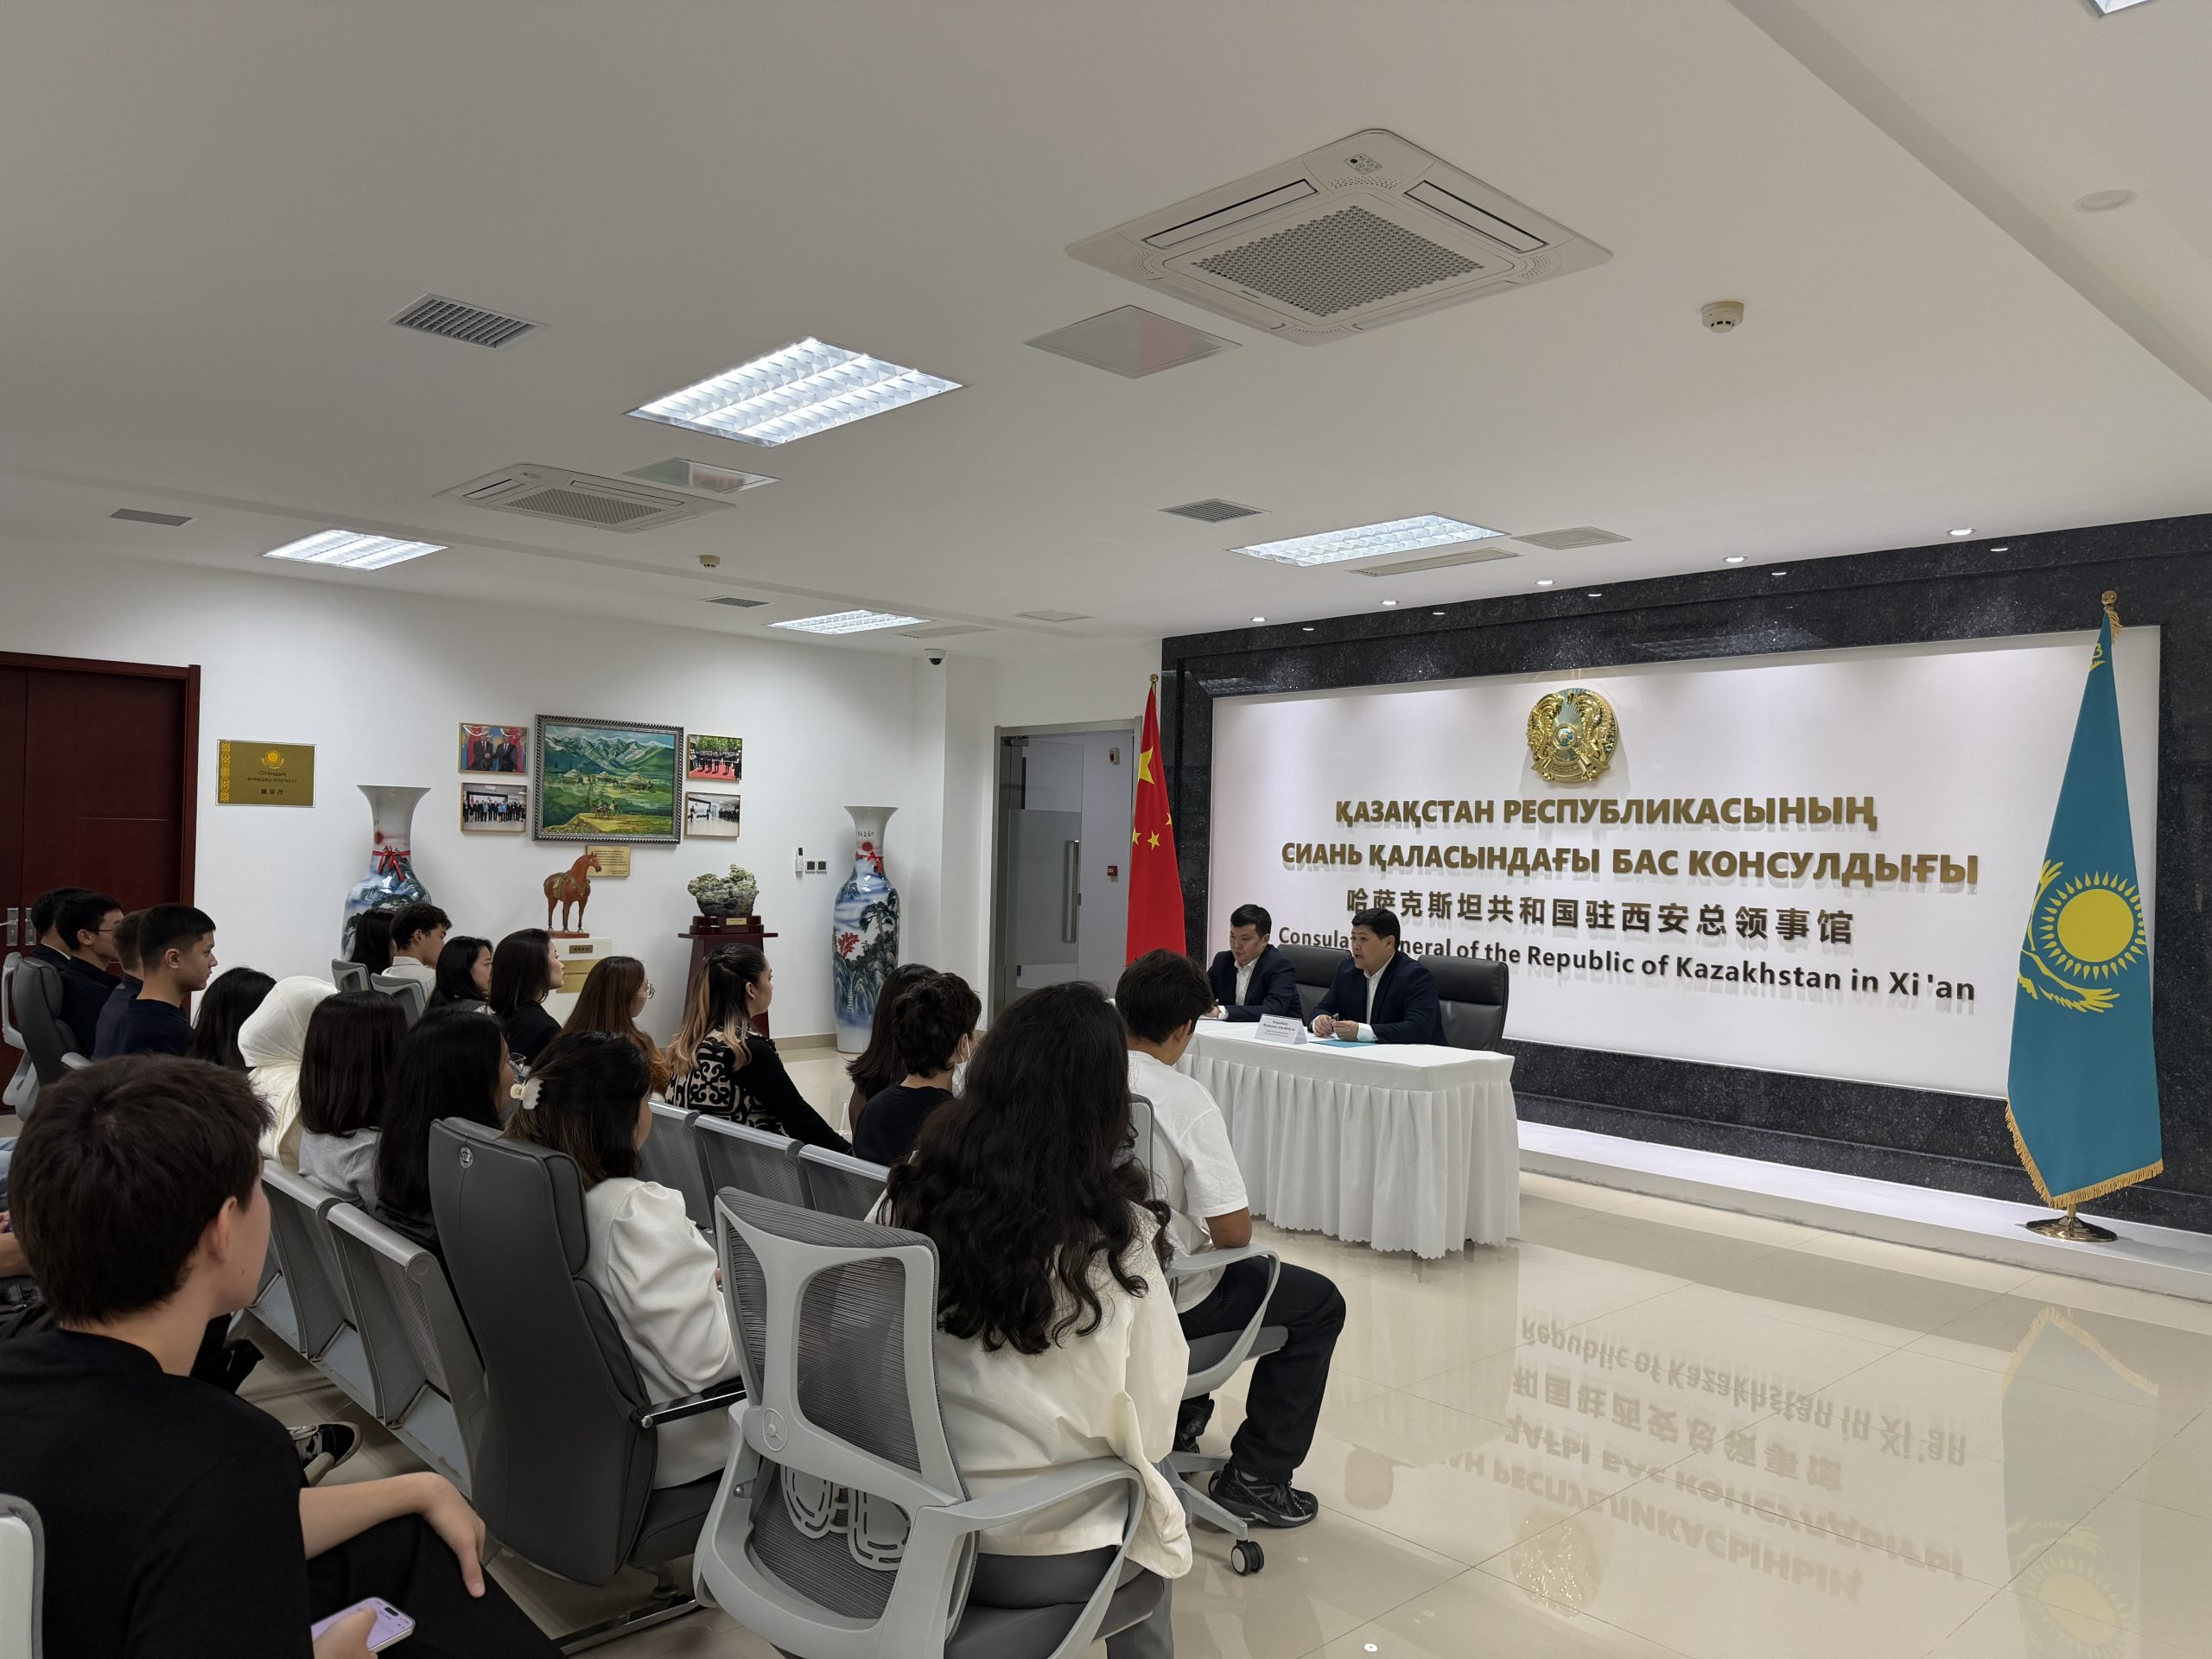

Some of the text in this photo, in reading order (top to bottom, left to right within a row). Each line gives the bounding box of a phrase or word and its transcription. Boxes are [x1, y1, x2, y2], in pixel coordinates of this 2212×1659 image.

[1336, 797, 1878, 831] ҚАЗАҚСТАН РЕСПУБЛИКАСЫНЫҢ
[1281, 842, 1978, 887] СИАНЬ ҚАЛАСЫНДАҒЫ БАС КОНСУЛДЫҒЫ
[1346, 887, 1853, 944] 哈萨克斯坦共和国驻西安总领事馆
[1279, 926, 1349, 949] Consula
[1400, 938, 1451, 957] neral
[1457, 939, 1479, 958] of
[1484, 943, 1521, 963] the
[1528, 945, 1635, 973] Republic
[1641, 955, 1670, 976] of
[1676, 957, 1840, 990] Kazakhstan
[1851, 969, 1878, 993] in
